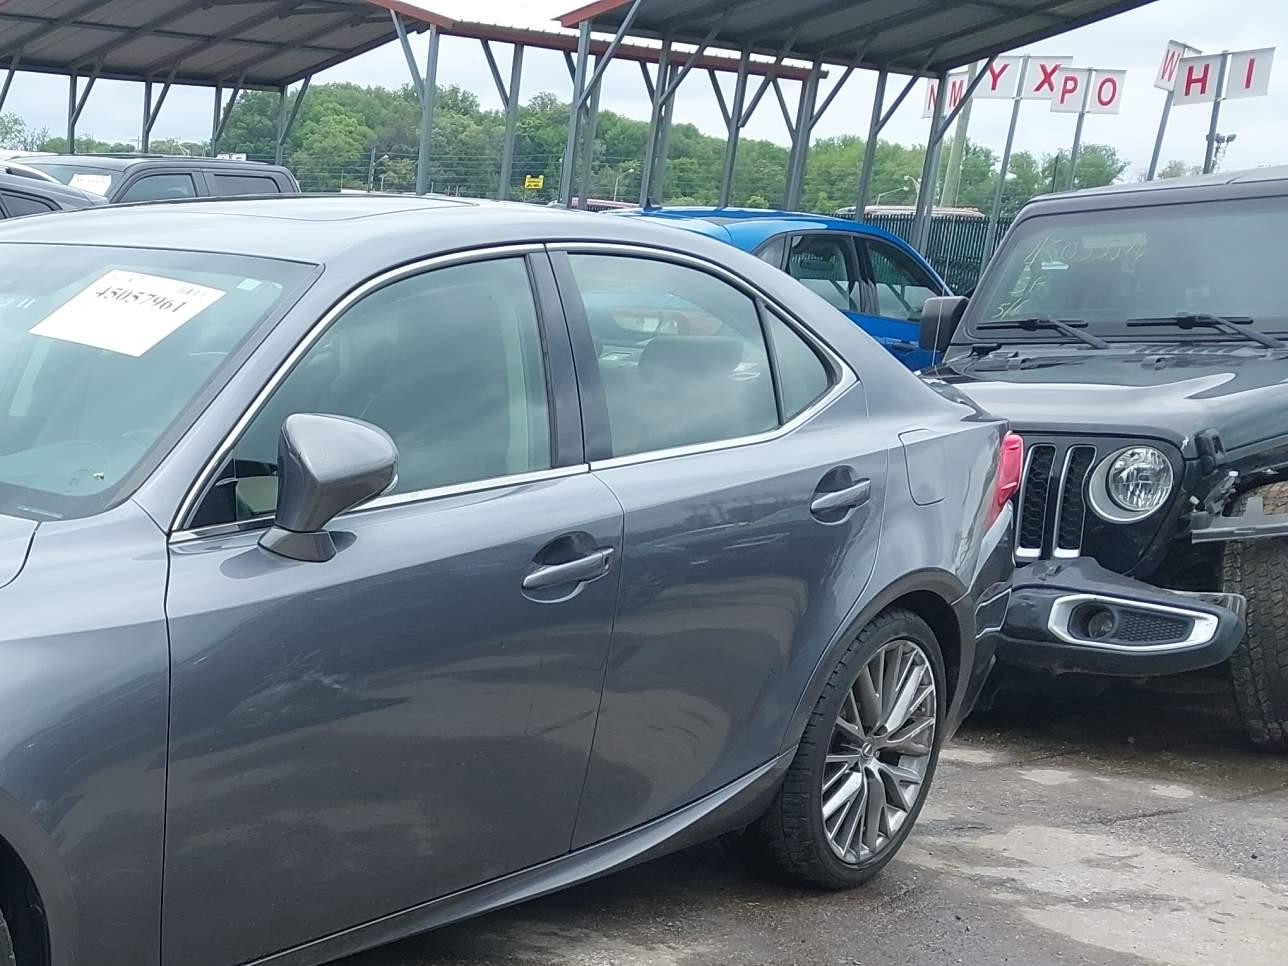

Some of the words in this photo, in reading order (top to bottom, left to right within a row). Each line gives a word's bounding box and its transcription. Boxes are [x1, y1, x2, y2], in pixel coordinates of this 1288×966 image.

[986, 63, 1010, 91] Y
[1033, 63, 1062, 92] X
[1060, 75, 1079, 105] P
[1184, 63, 1211, 97] H
[95, 286, 187, 312] 45057961
